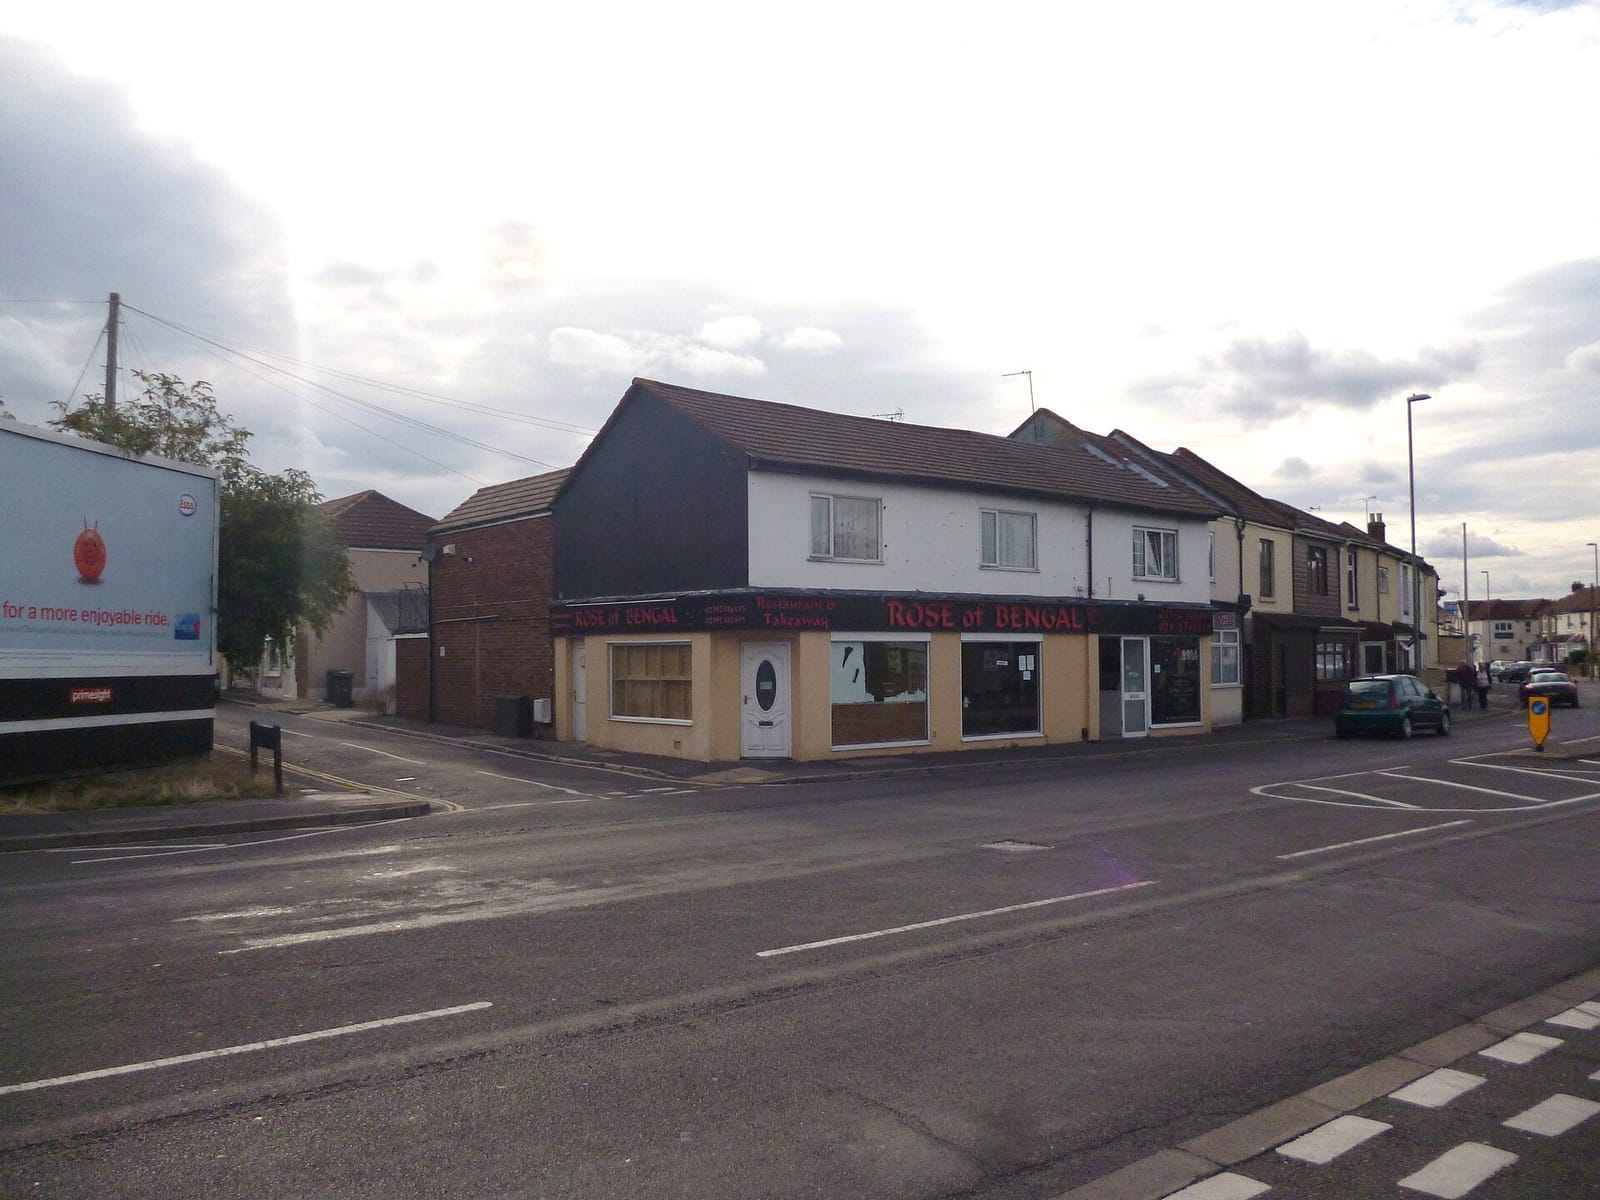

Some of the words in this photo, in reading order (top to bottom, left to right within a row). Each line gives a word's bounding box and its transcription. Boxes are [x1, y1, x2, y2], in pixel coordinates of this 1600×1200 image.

[180, 499, 194, 510] Esso
[2, 601, 24, 619] for
[28, 606, 37, 620] a
[41, 607, 77, 622] more
[81, 607, 142, 627] enjoyable
[145, 610, 170, 627] ride.
[575, 605, 606, 627] ROSE
[625, 605, 679, 625] BENGAL
[764, 612, 829, 630] Takeaway
[888, 601, 955, 628] ROSE
[962, 603, 985, 628] of
[995, 605, 1084, 630] BENGAL
